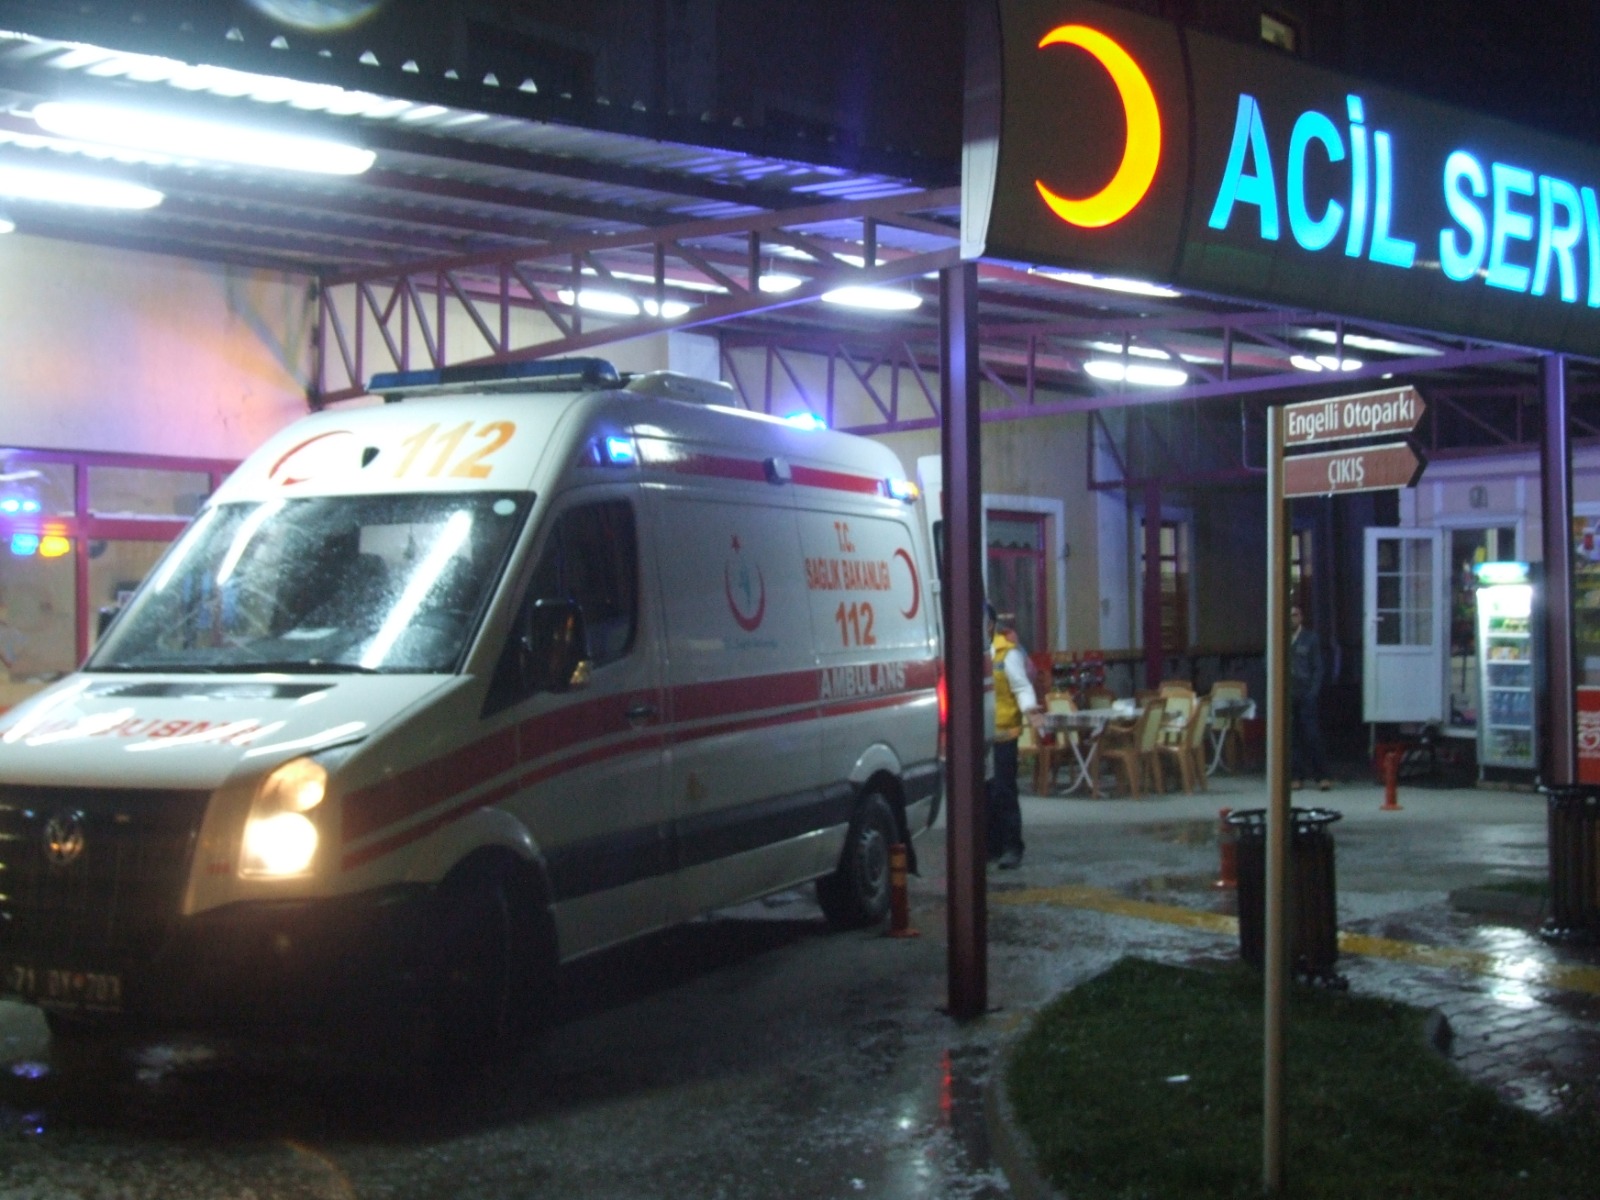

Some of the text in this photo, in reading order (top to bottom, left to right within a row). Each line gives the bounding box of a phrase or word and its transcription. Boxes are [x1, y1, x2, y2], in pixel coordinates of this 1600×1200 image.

[1208, 93, 1416, 269] ACİL
[1288, 392, 1416, 440] Engelli Otoparkı
[391, 419, 517, 480] 112
[1327, 456, 1365, 490] ÇIKIŞ
[834, 601, 877, 647] 112
[820, 662, 906, 699] AMBULANS
